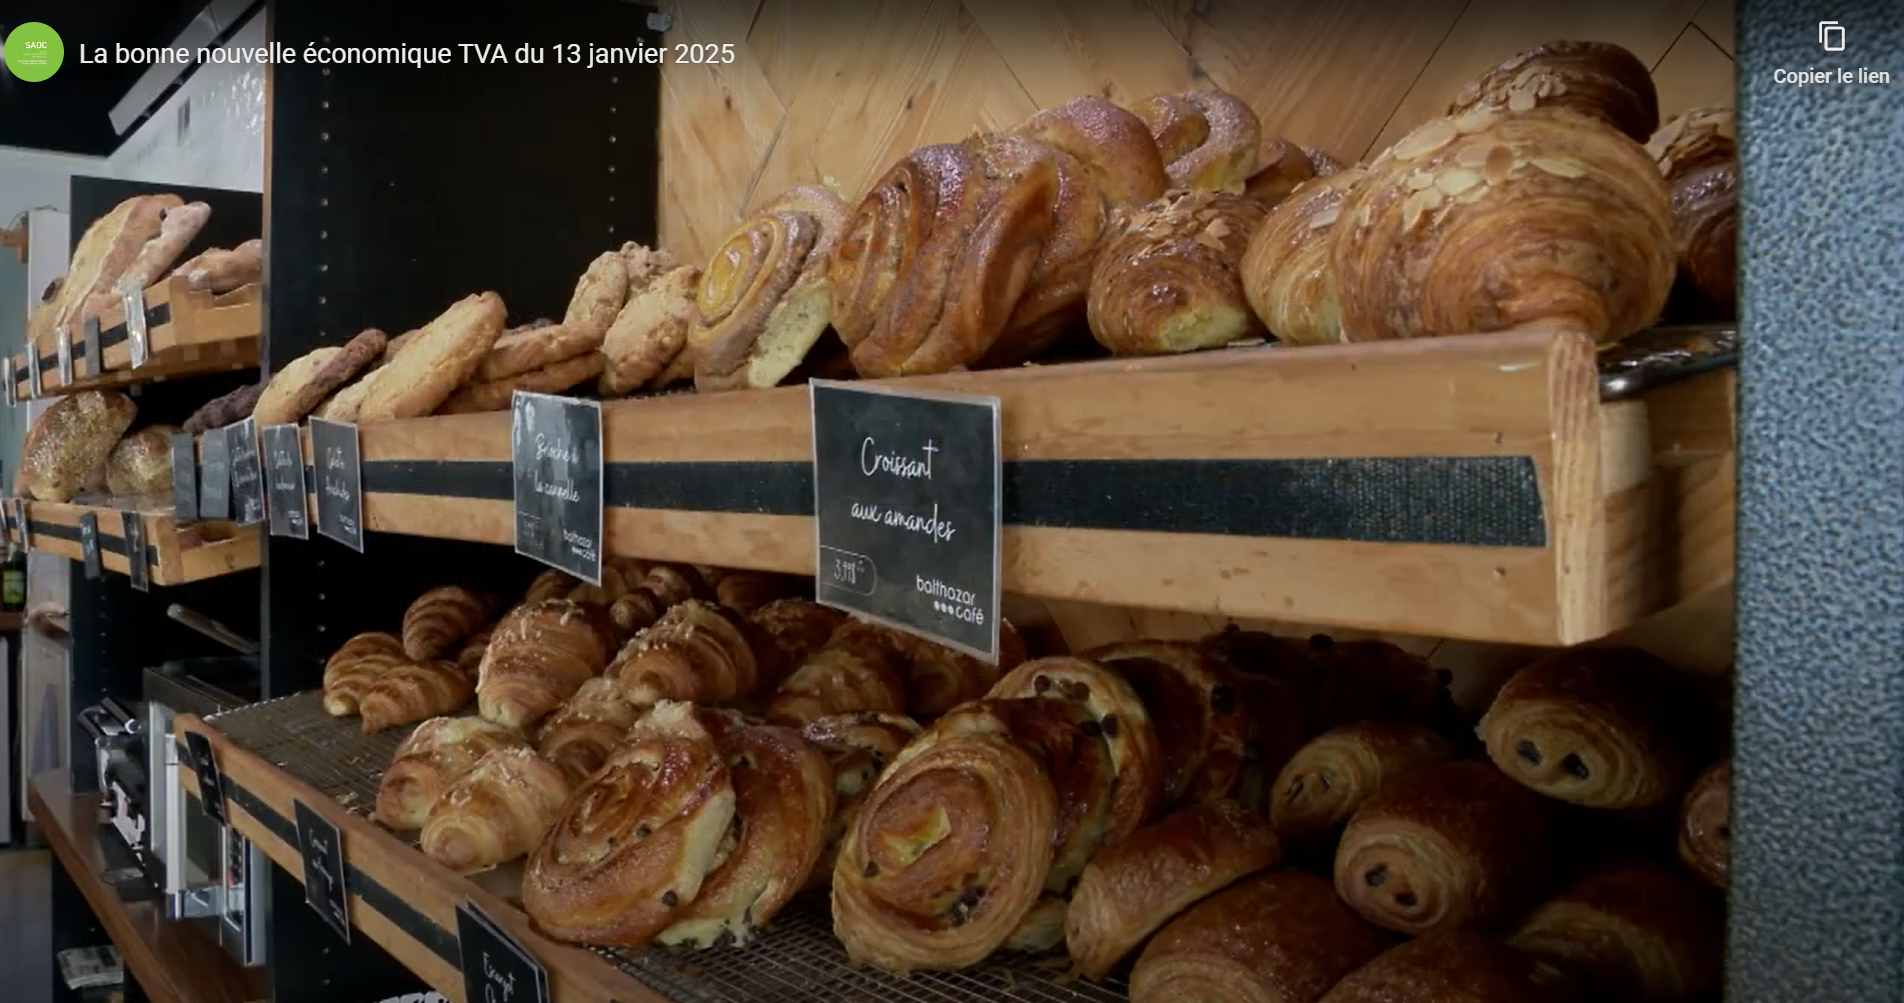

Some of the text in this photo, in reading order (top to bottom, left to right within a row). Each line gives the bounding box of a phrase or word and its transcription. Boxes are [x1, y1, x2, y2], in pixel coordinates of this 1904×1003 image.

[861, 436, 940, 480] Croissant
[851, 501, 956, 544] aux amandes
[916, 574, 976, 607] balthazar
[955, 604, 985, 625] café
